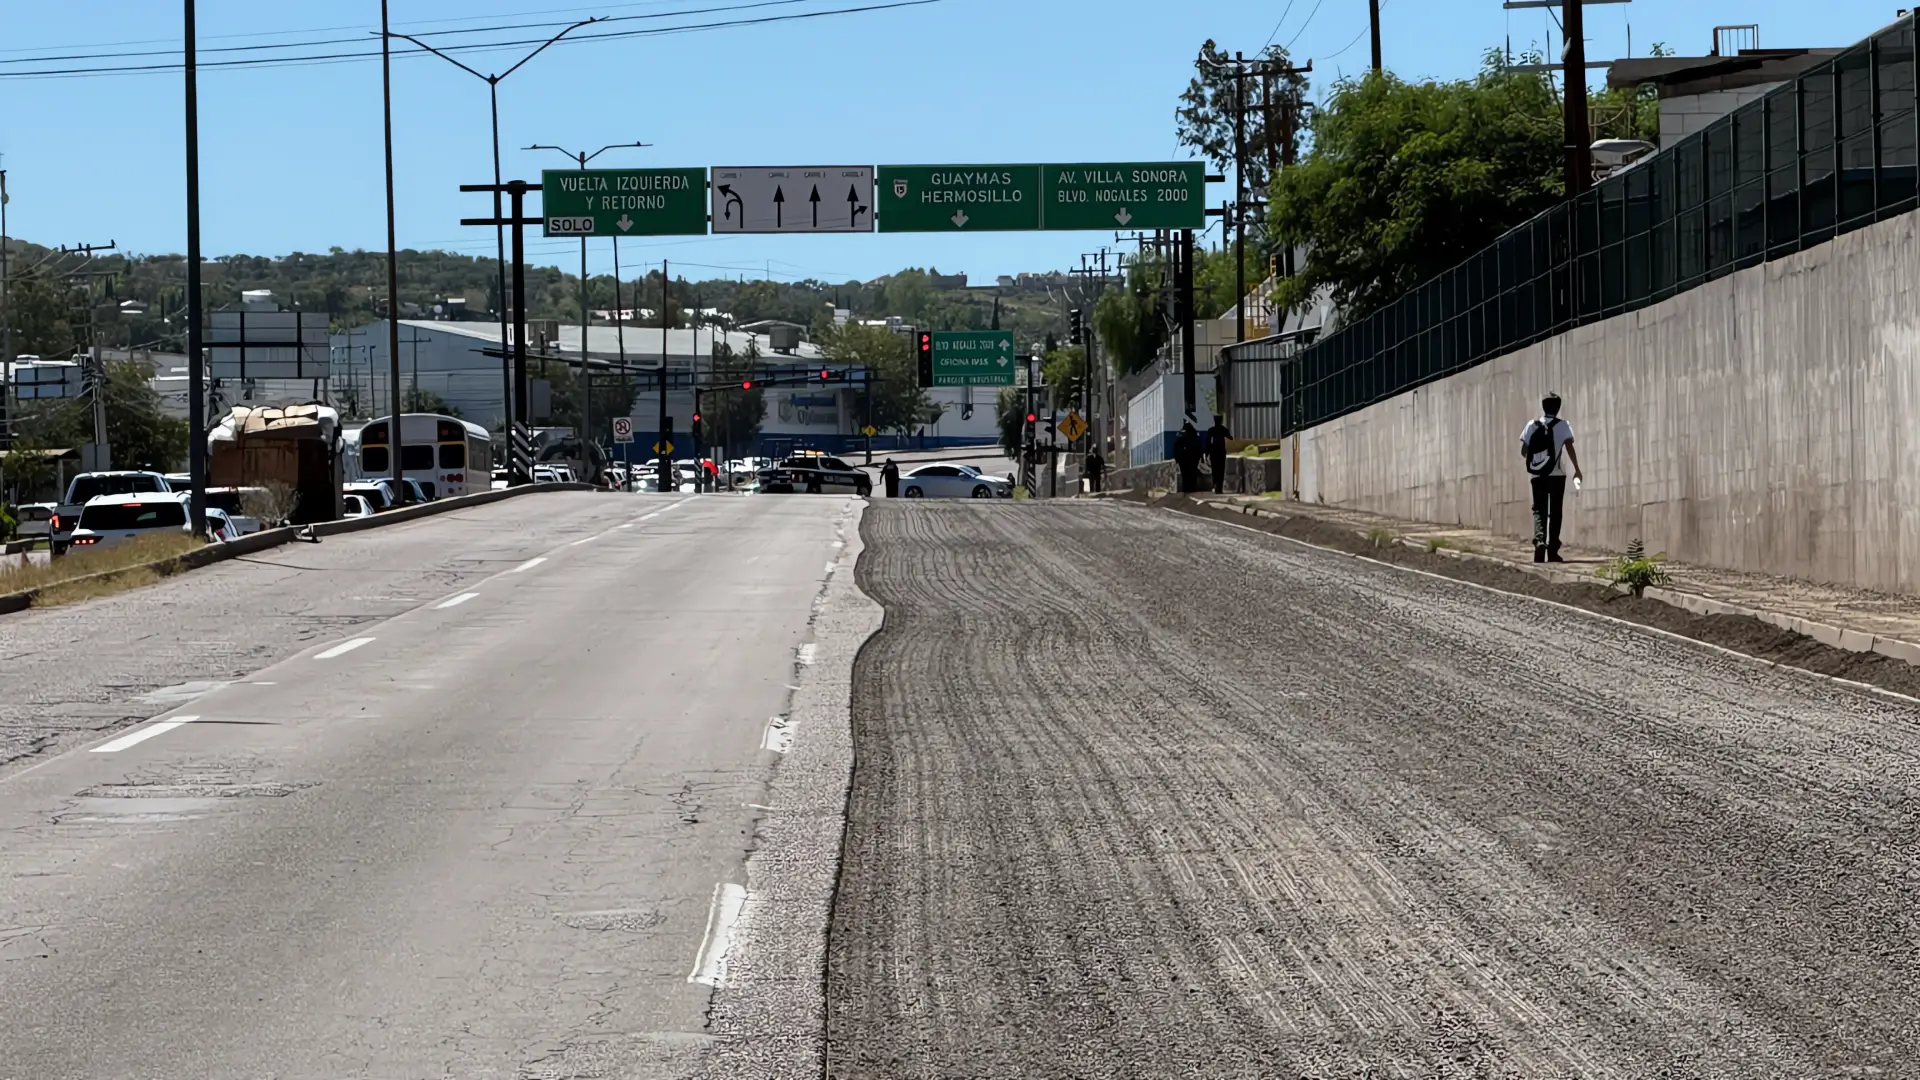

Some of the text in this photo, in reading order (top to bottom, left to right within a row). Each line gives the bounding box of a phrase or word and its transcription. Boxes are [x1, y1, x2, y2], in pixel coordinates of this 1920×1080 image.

[560, 176, 689, 191] VUELTA IZQUIERDA
[931, 172, 1011, 186] GUAYMAS
[1058, 170, 1187, 184] AV. VILLA SONORA
[586, 195, 665, 210] Y RETORNO
[921, 190, 1022, 203] HERMOSILLO
[1058, 189, 1188, 203] BLVD. NOGALES 2000
[551, 219, 593, 231] SOLO
